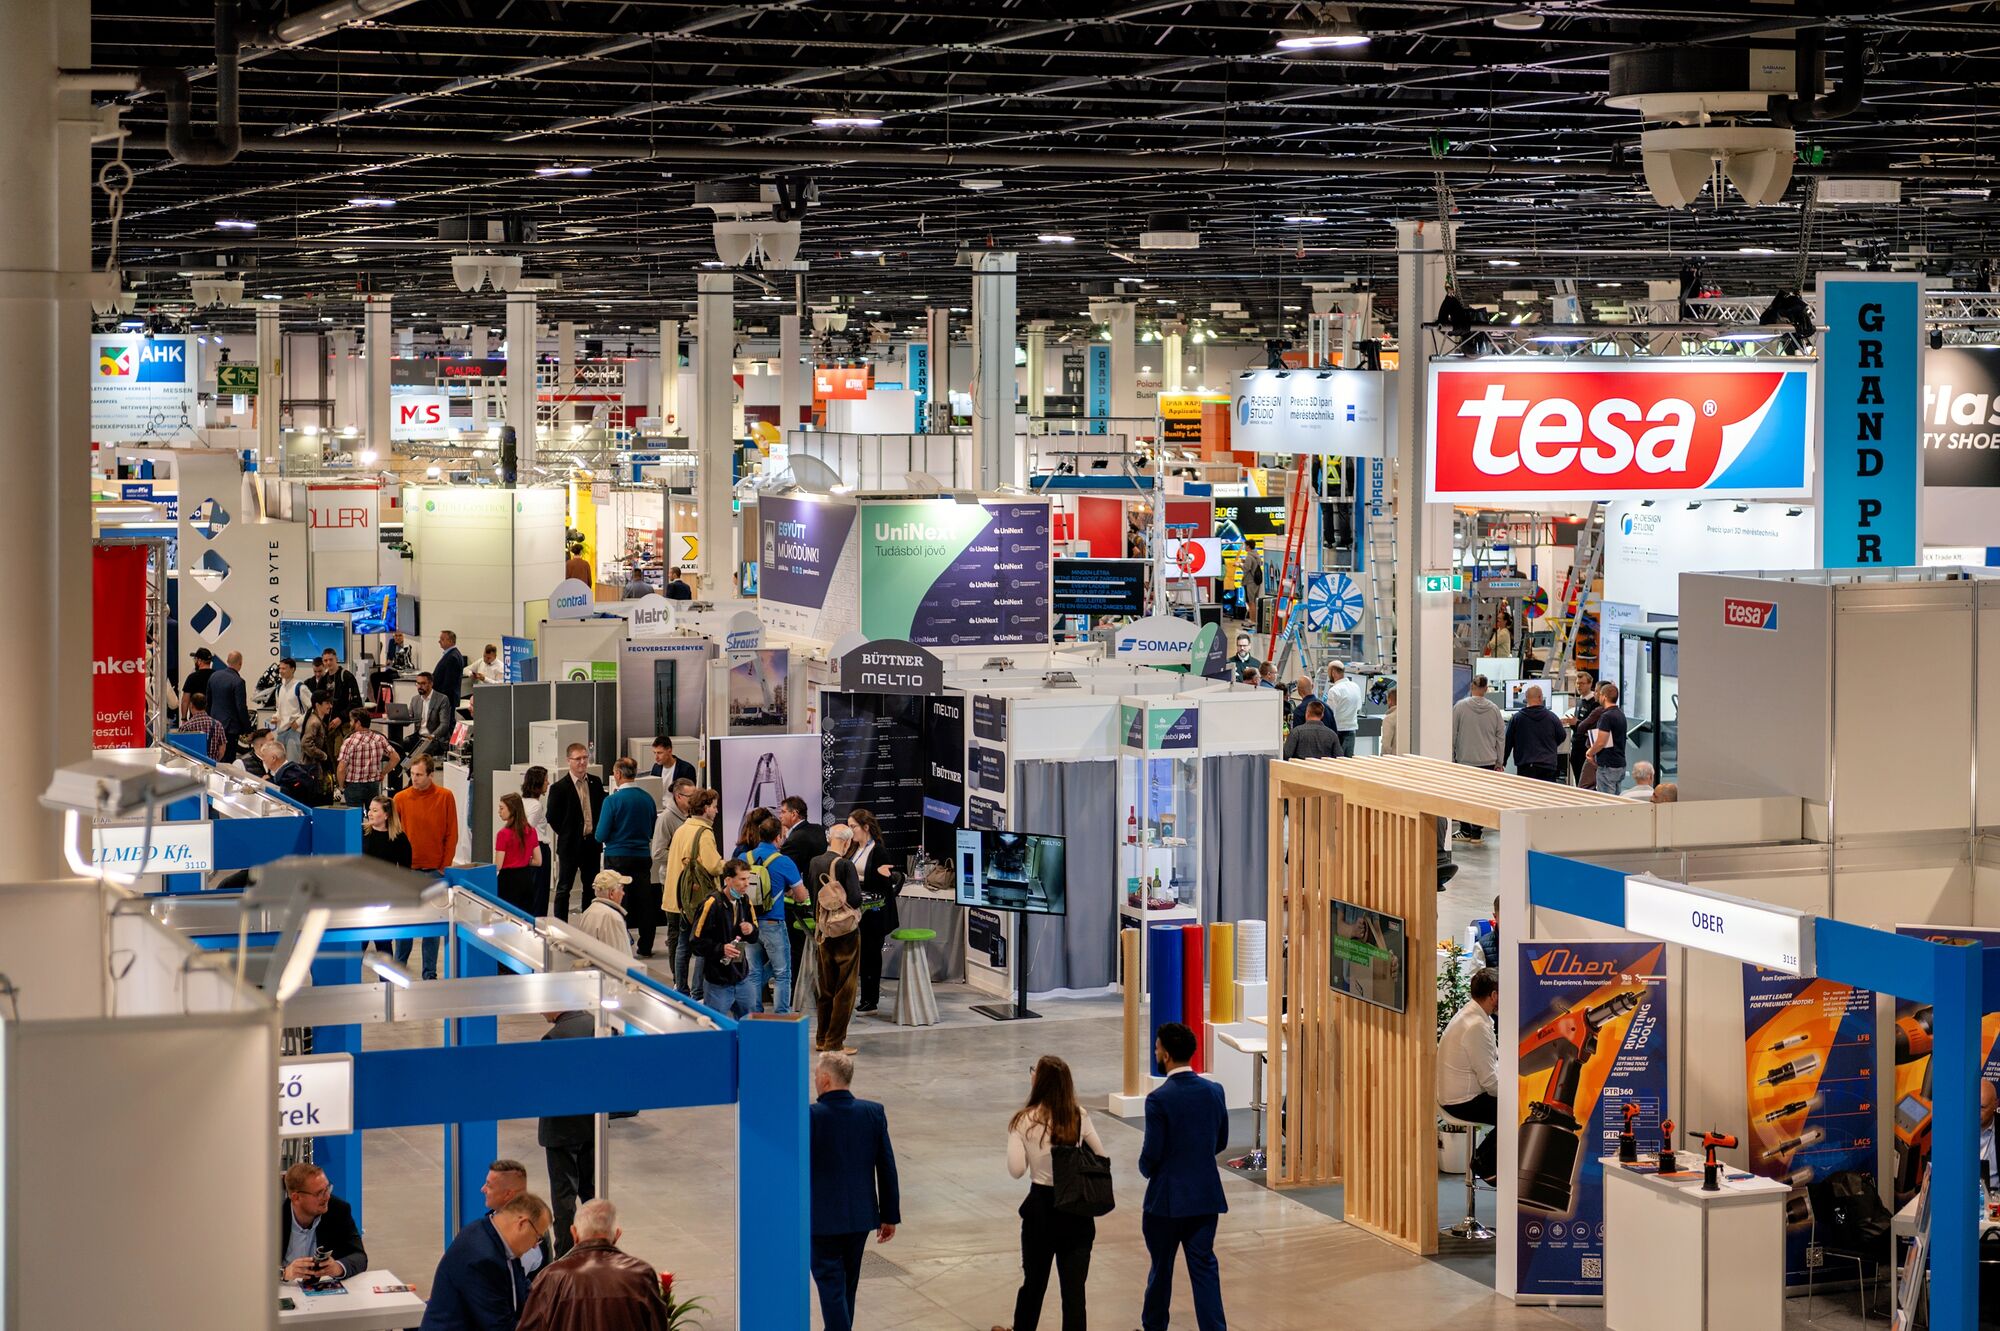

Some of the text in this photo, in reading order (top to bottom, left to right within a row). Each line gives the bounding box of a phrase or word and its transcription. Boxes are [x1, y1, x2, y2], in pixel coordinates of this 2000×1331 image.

[140, 345, 183, 363] AHK
[1098, 351, 1106, 395] GRAND
[1136, 380, 1163, 388] Poland
[1856, 303, 1885, 477] GRAND
[400, 404, 440, 424] MLS
[1250, 408, 1274, 419] STUDIO
[1456, 384, 1697, 475] tesa
[875, 523, 957, 541] UniNext
[1857, 499, 1882, 562] PR
[874, 545, 923, 557] Tudásból
[269, 540, 280, 656] OMEGA BYTE
[556, 594, 587, 608] contrail
[634, 606, 669, 624] Matro
[1727, 601, 1762, 624] tesa
[628, 644, 704, 652] FEGYVERSZEKRÉNYEK
[727, 633, 759, 650] Strauss
[861, 652, 924, 667] BÜTTNER
[861, 672, 923, 687] MELTIO
[97, 710, 133, 723] ügyfél
[933, 703, 959, 720] MELTIO
[936, 766, 962, 783] BÜTTNER
[164, 844, 193, 864] Kft.
[185, 861, 207, 869] 311D
[1692, 910, 1724, 934] OBER
[1782, 954, 1797, 966] 311E
[1761, 1000, 1792, 1008] PNEUMATIC
[1623, 1003, 1651, 1050] RIVETING
[1635, 1016, 1657, 1050] TOOLS
